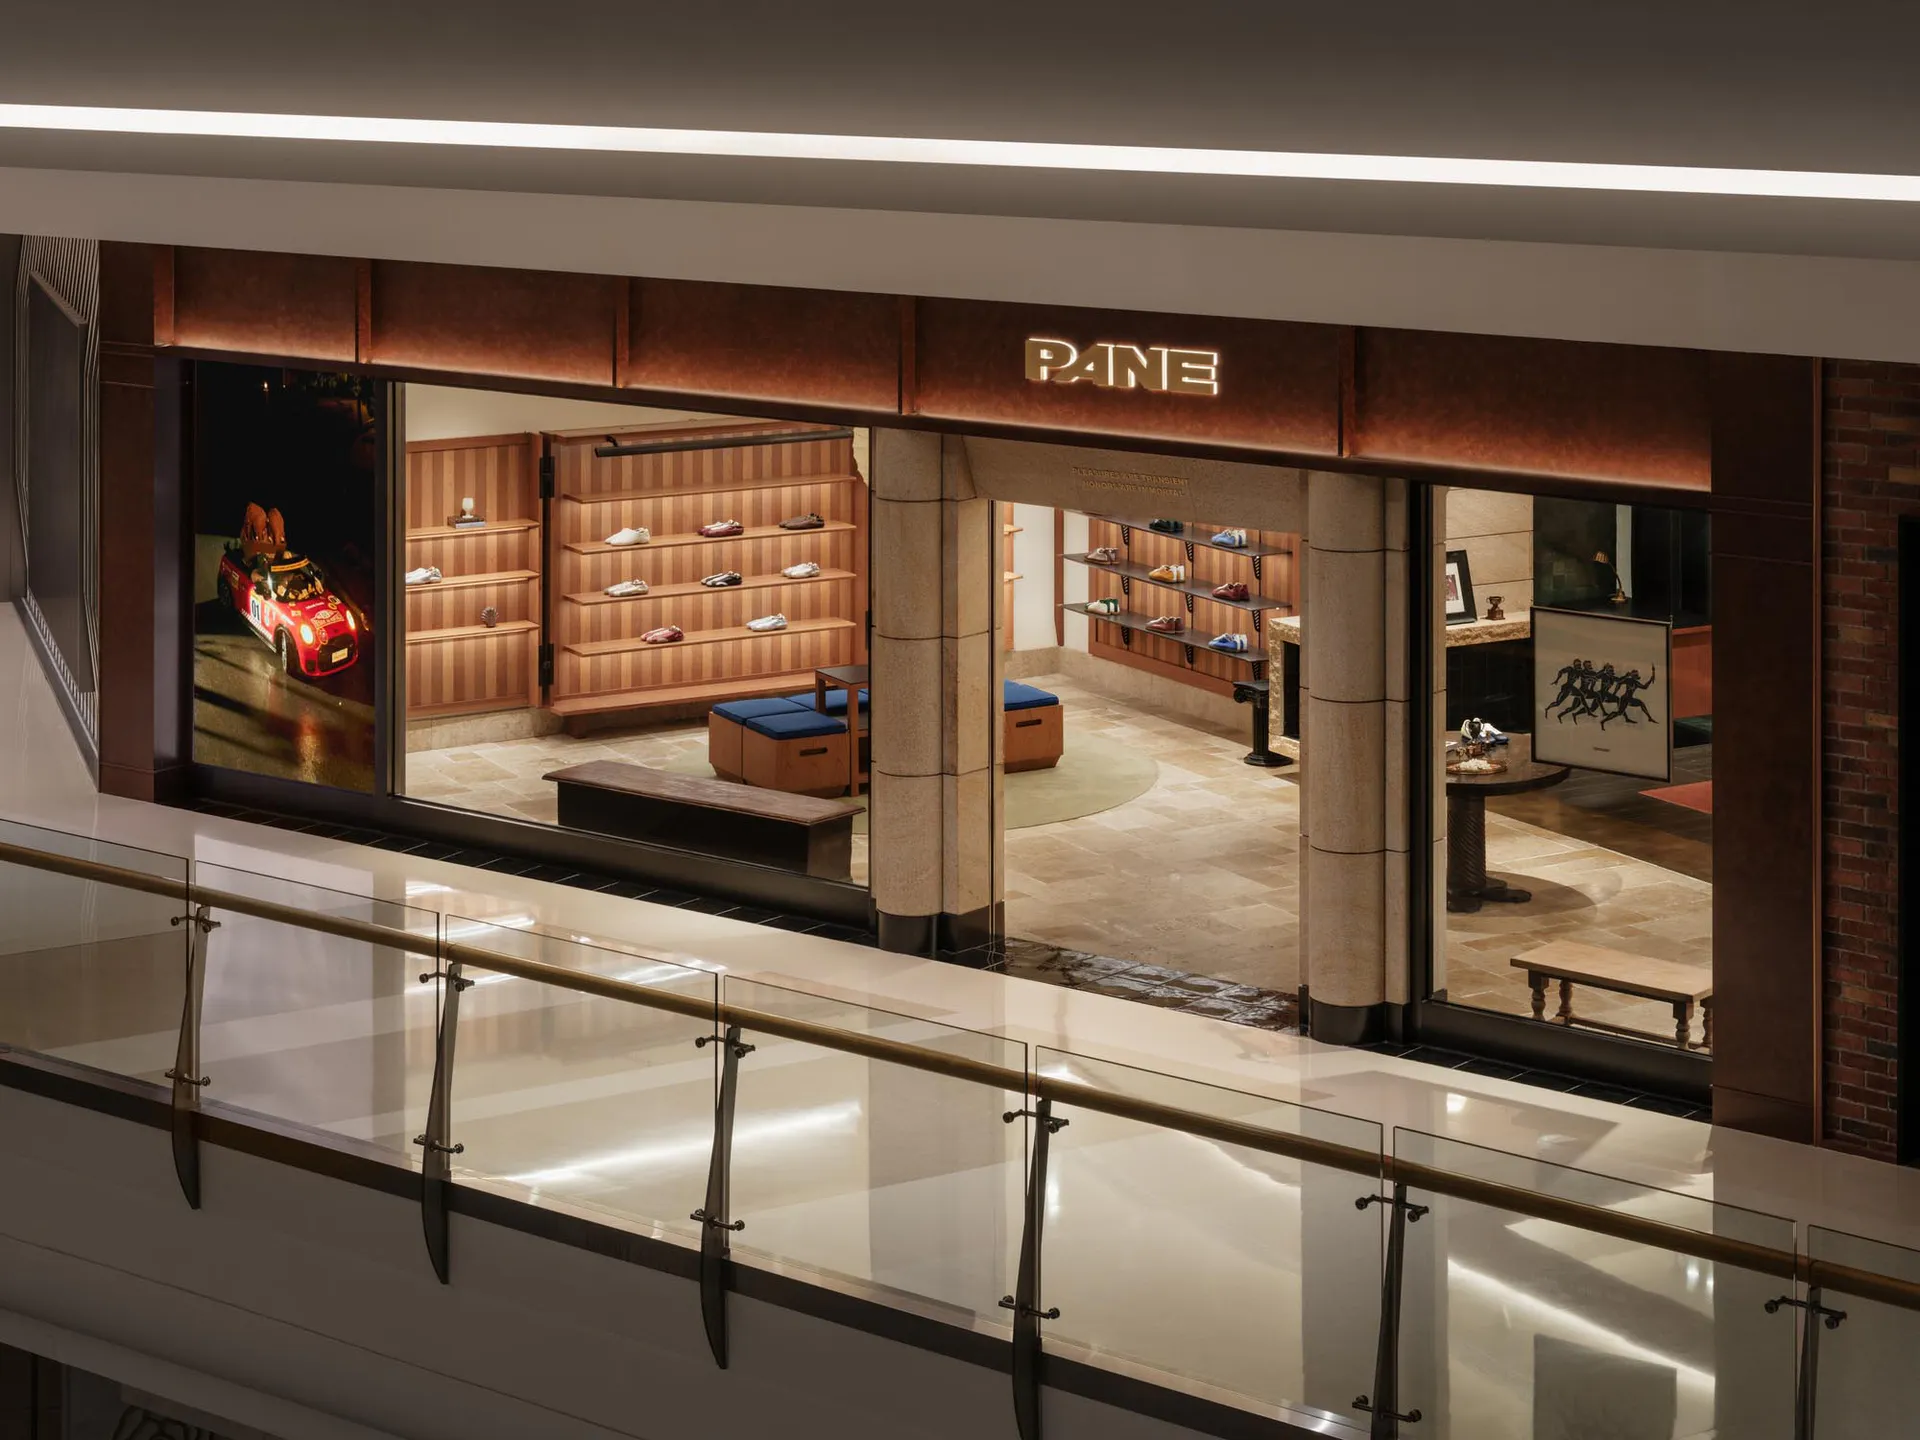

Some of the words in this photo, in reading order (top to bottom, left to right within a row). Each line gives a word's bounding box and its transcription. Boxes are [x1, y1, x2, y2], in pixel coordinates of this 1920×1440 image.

[1025, 338, 1218, 395] PANE
[1119, 483, 1137, 492] ARE
[1122, 472, 1140, 482] ARE
[1140, 474, 1189, 487] TRANSIENT
[251, 599, 260, 621] 01
